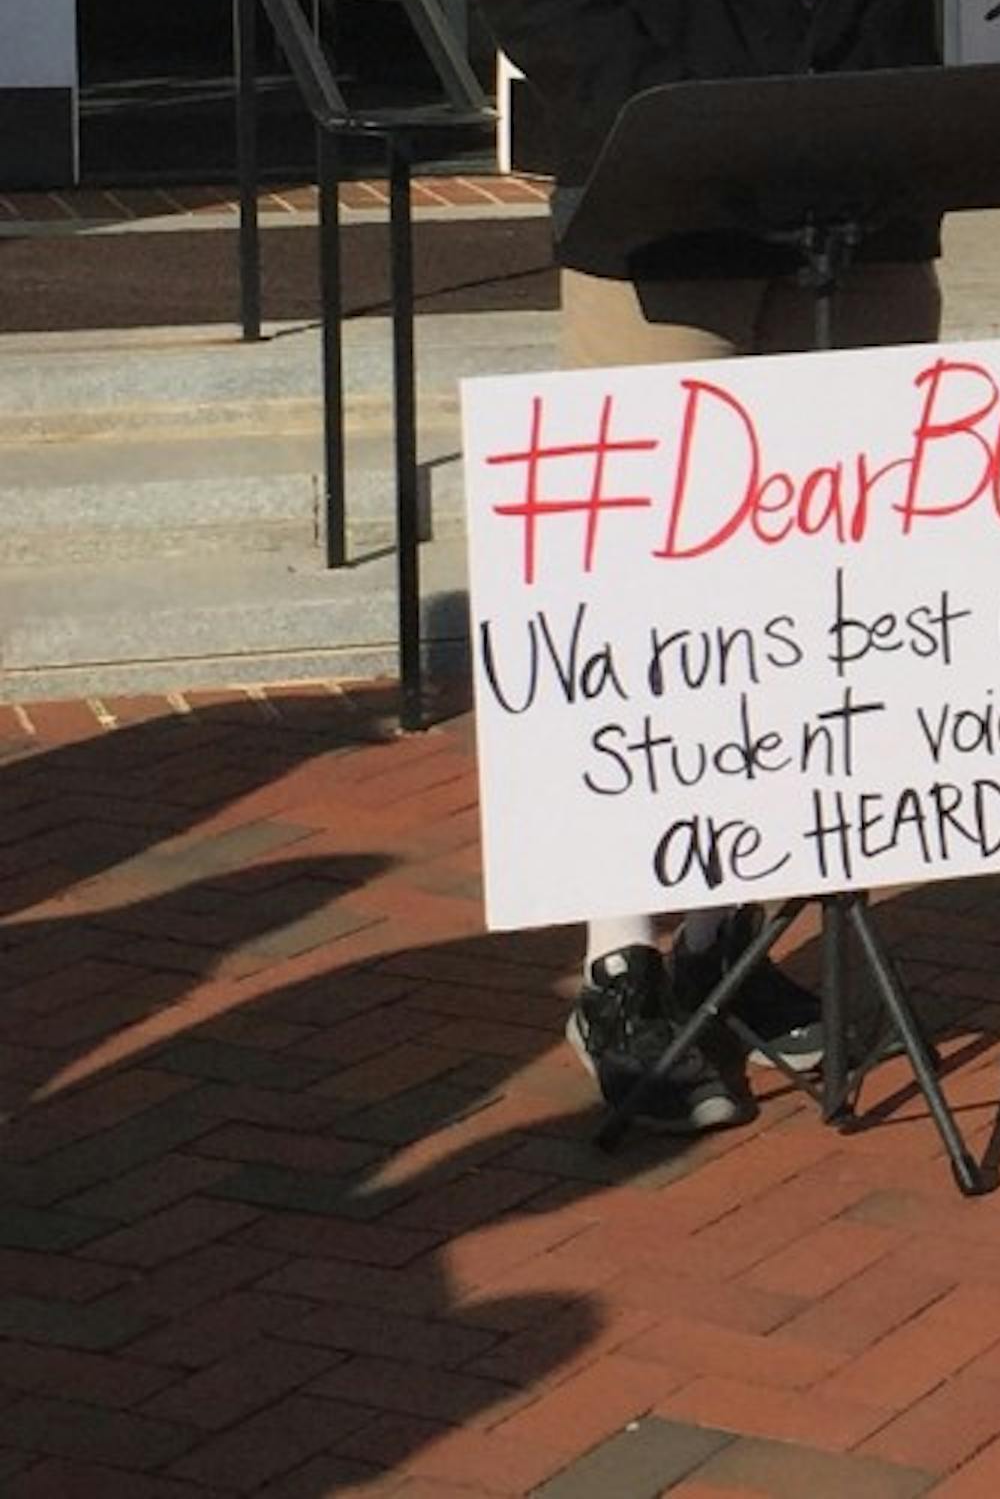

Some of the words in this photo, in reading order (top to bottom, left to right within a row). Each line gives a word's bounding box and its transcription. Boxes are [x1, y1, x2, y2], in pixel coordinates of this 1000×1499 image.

[480, 602, 629, 714] UVa
[648, 615, 802, 698] runs
[828, 568, 971, 676] best
[583, 687, 884, 795] student
[652, 811, 792, 890] are
